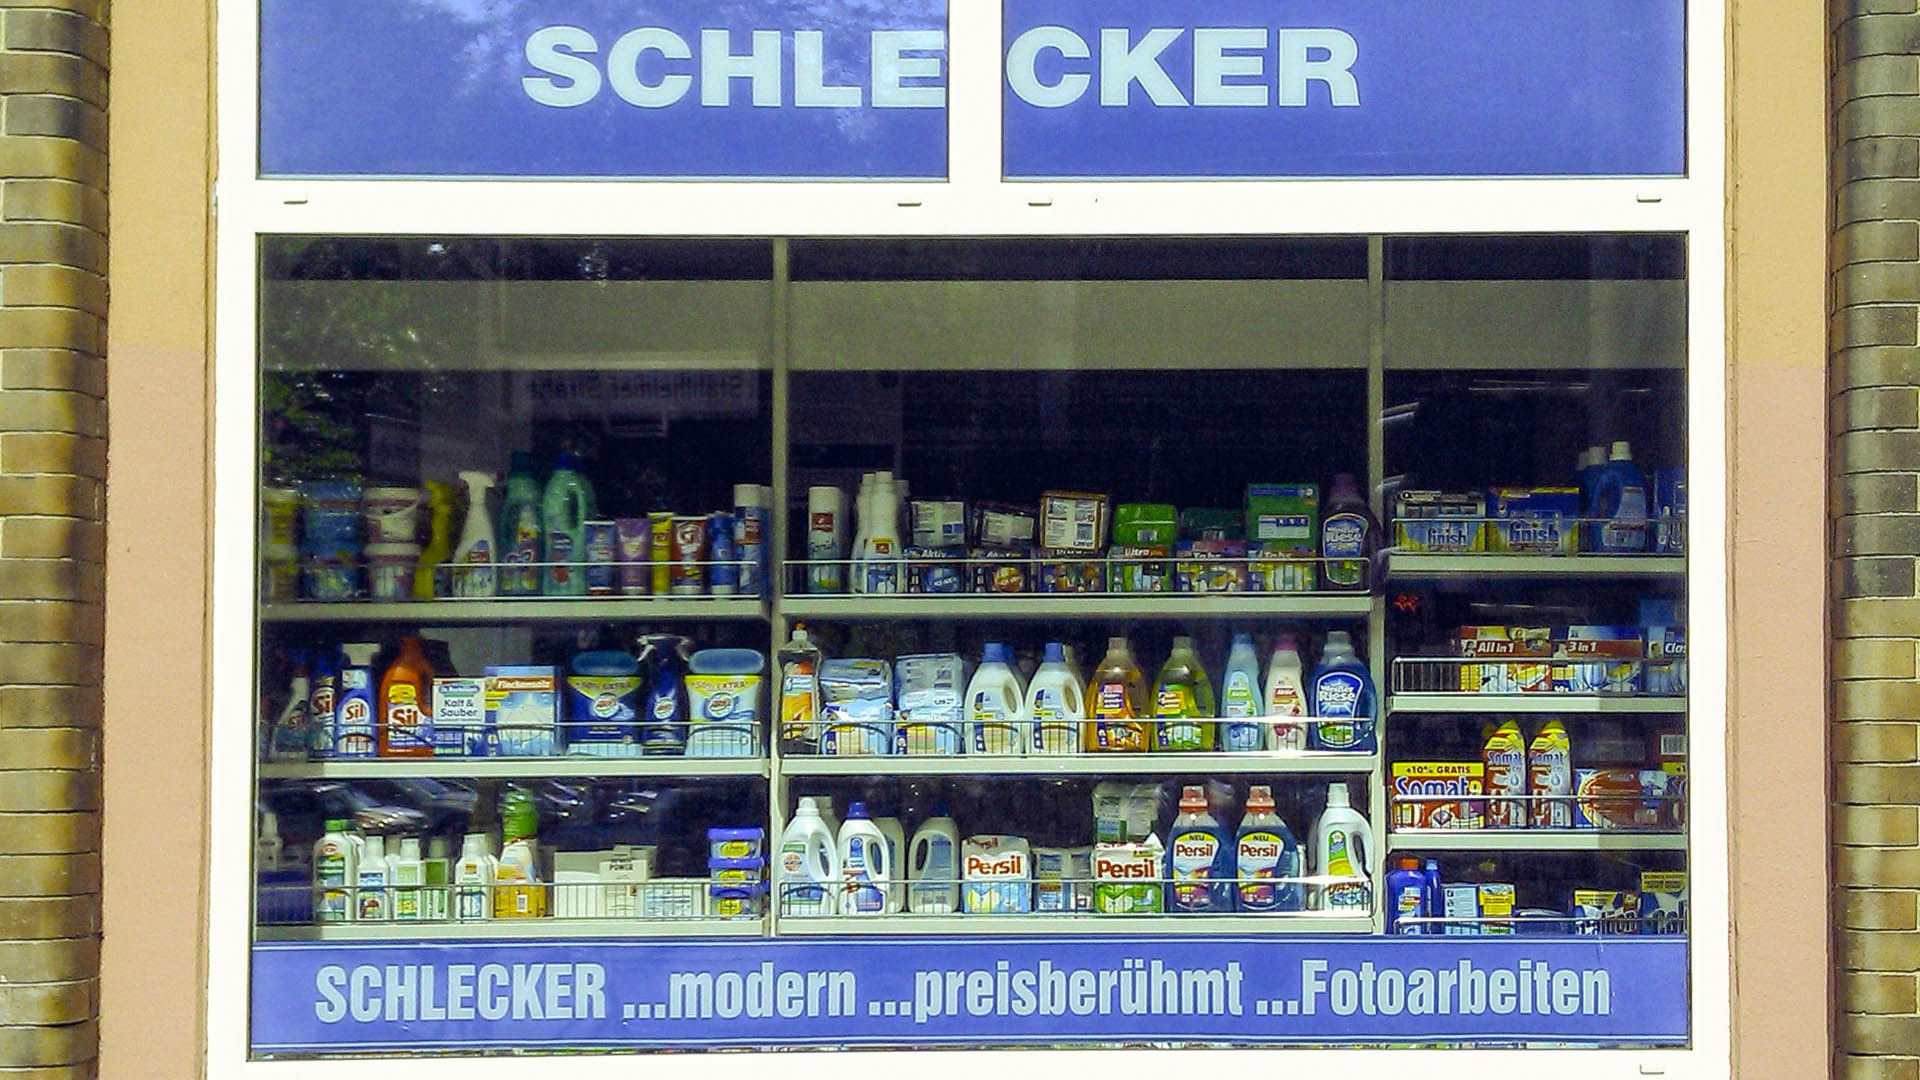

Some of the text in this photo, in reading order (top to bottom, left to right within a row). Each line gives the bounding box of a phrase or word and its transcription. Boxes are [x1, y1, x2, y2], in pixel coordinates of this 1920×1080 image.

[522, 25, 1361, 109] SCHLECKER
[1428, 527, 1467, 546] finish
[1510, 522, 1559, 544] finish
[1477, 640, 1494, 654] All
[1568, 642, 1577, 652] 3
[1578, 642, 1589, 653] in
[346, 703, 364, 721] Sil
[440, 707, 478, 717] Sauber
[444, 699, 464, 707] Kalt
[392, 708, 418, 726] Sil
[1437, 765, 1471, 775] GRATIS
[1394, 775, 1470, 796] Somat
[1176, 843, 1214, 857] Persil
[1240, 844, 1278, 857] Persil
[968, 855, 1021, 875] Persil
[1096, 858, 1155, 878] Persil
[315, 958, 1611, 1023] SCHLECKER ...modern ...preisberühmt ...Fotoarbeiten
